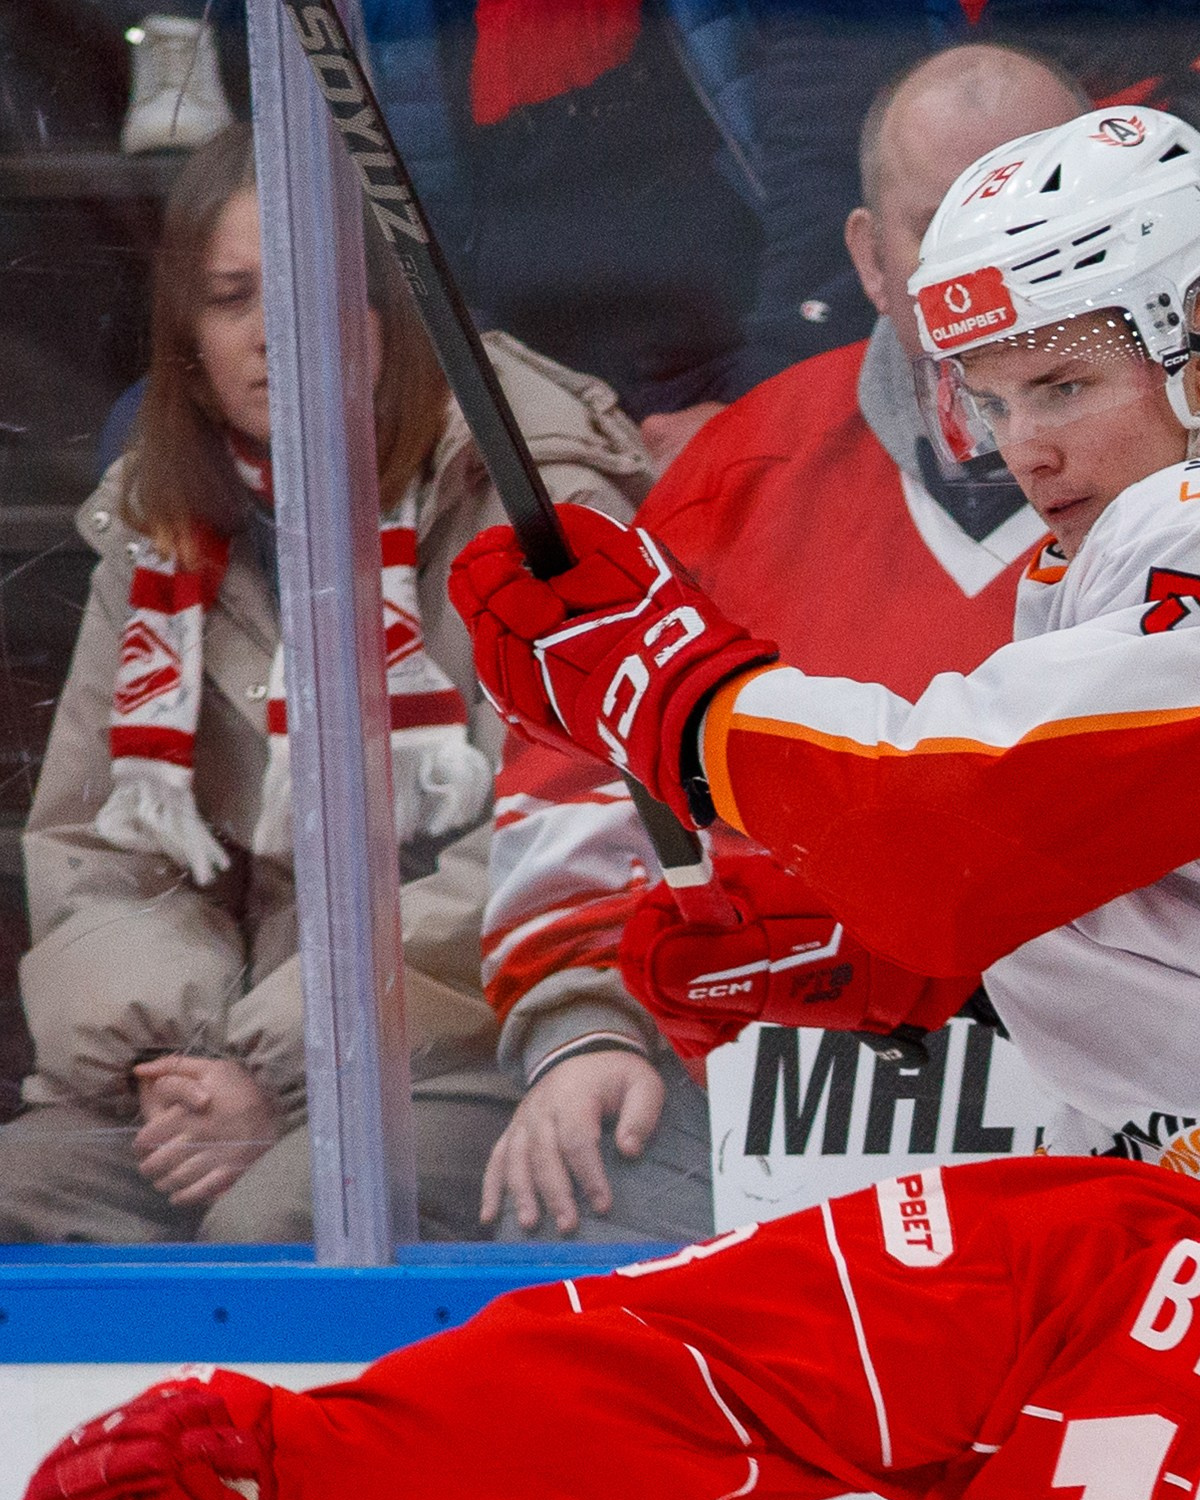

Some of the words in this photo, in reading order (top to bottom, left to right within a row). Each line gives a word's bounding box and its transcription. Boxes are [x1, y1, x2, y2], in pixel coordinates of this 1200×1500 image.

[286, 4, 429, 243] SOYUZ
[932, 307, 1007, 342] OLIMPBET
[1163, 352, 1190, 369] CCM
[687, 981, 753, 1000] CCM
[896, 1174, 934, 1252] PBET
